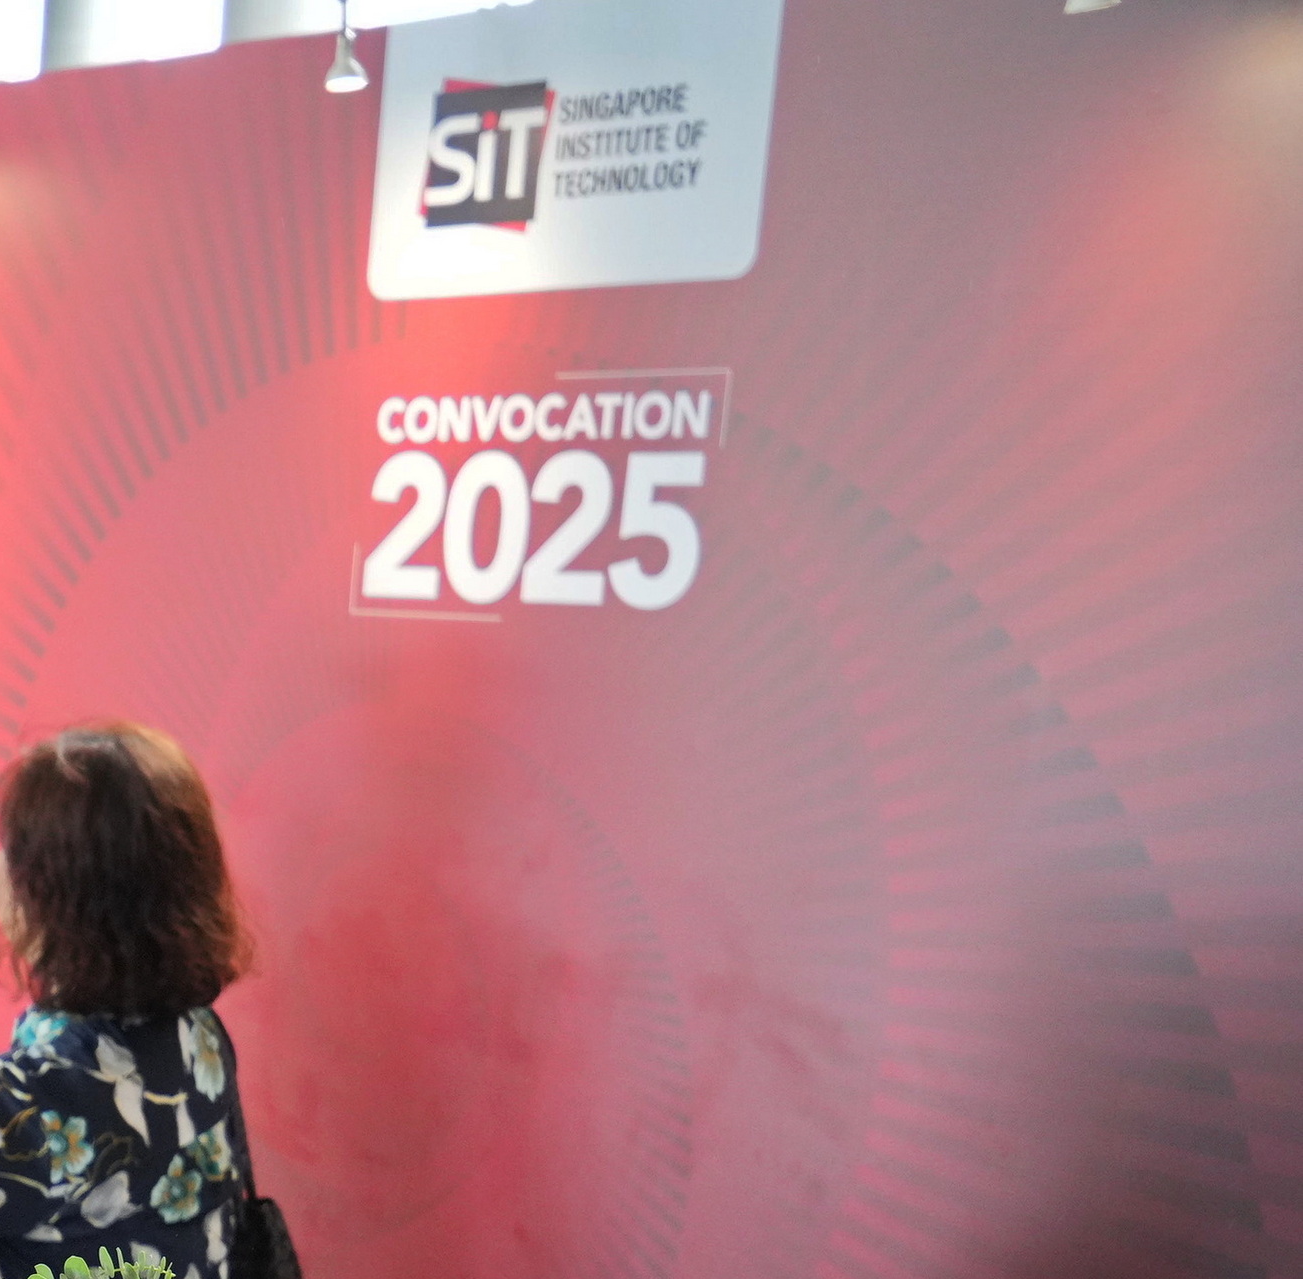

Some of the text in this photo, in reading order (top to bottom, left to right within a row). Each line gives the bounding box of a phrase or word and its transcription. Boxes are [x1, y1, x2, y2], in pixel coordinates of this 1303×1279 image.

[559, 83, 690, 123] SINGAPORE
[554, 120, 708, 161] INSTITUTE OF
[553, 157, 703, 199] TECHNOLOGY
[376, 389, 712, 444] CONVOCATION
[361, 448, 706, 611] 2025
